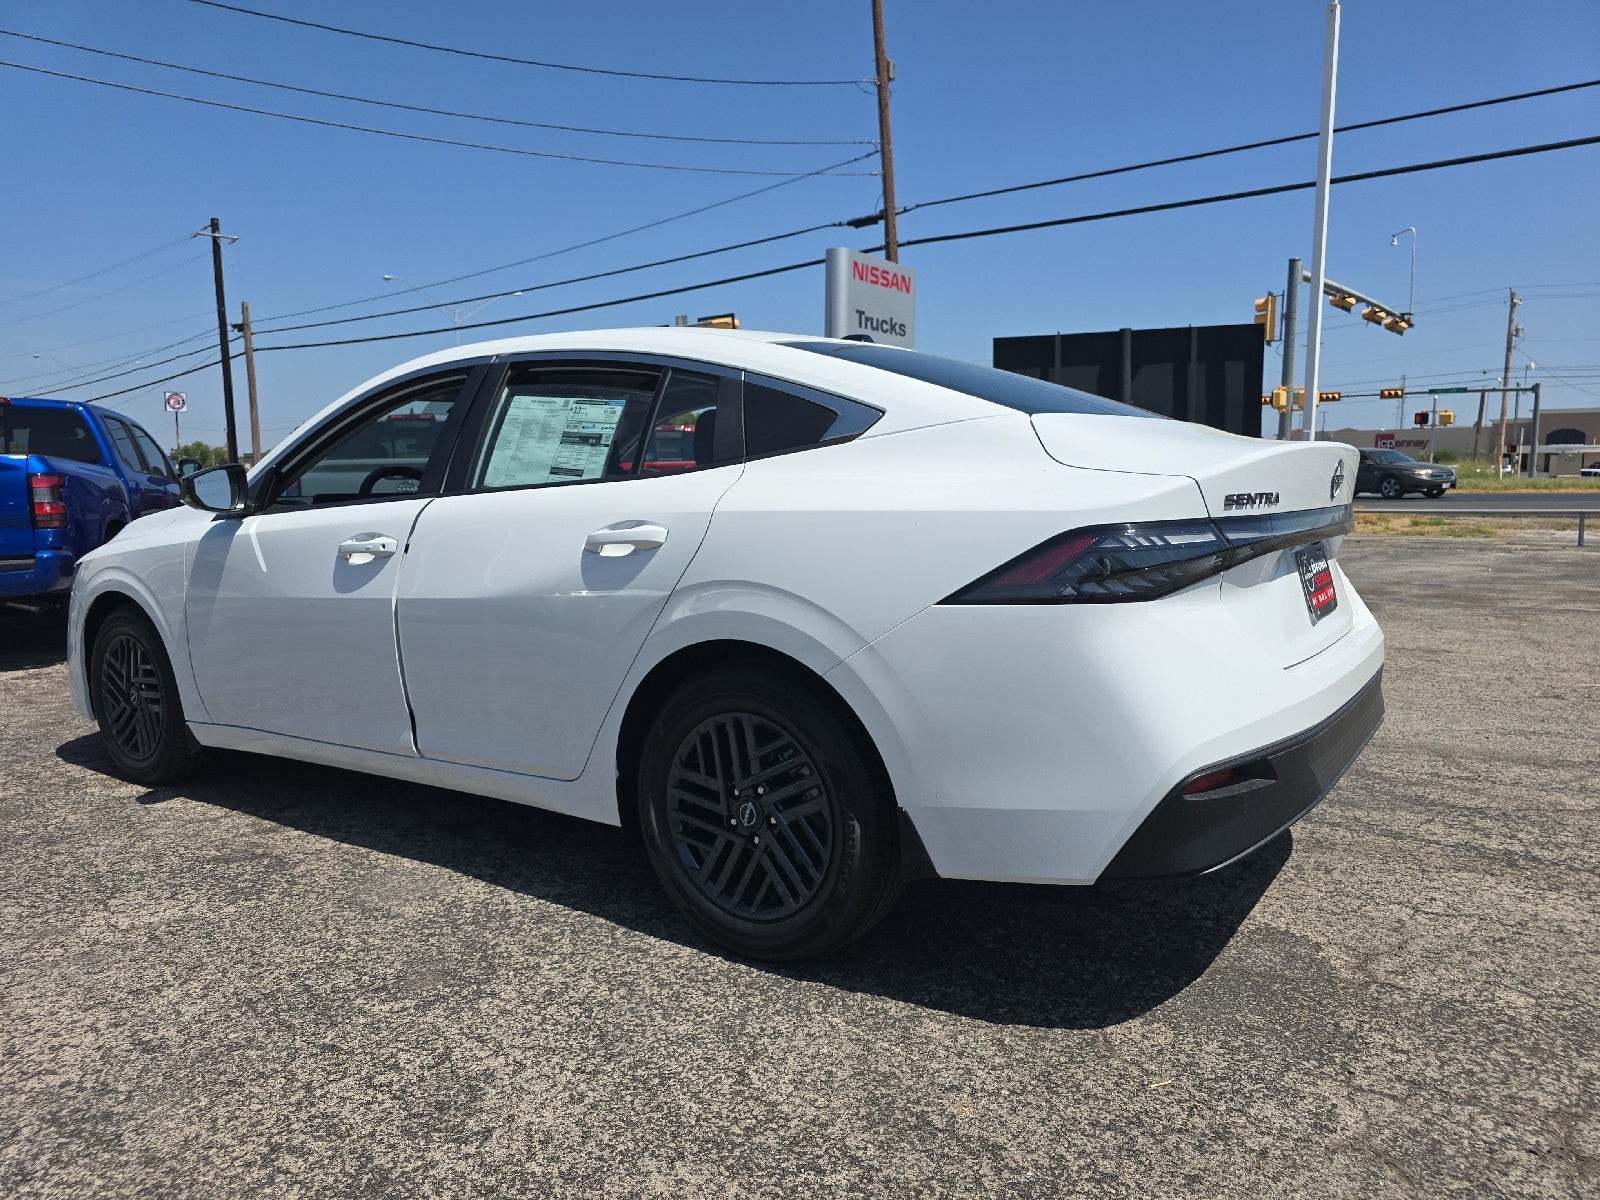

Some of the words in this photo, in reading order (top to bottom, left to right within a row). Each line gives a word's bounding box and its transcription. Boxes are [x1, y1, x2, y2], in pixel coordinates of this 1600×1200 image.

[852, 261, 911, 294] NISSAN
[855, 309, 907, 337] Trucks
[1377, 438, 1429, 449] jcpenney
[1223, 492, 1280, 507] SENTRA
